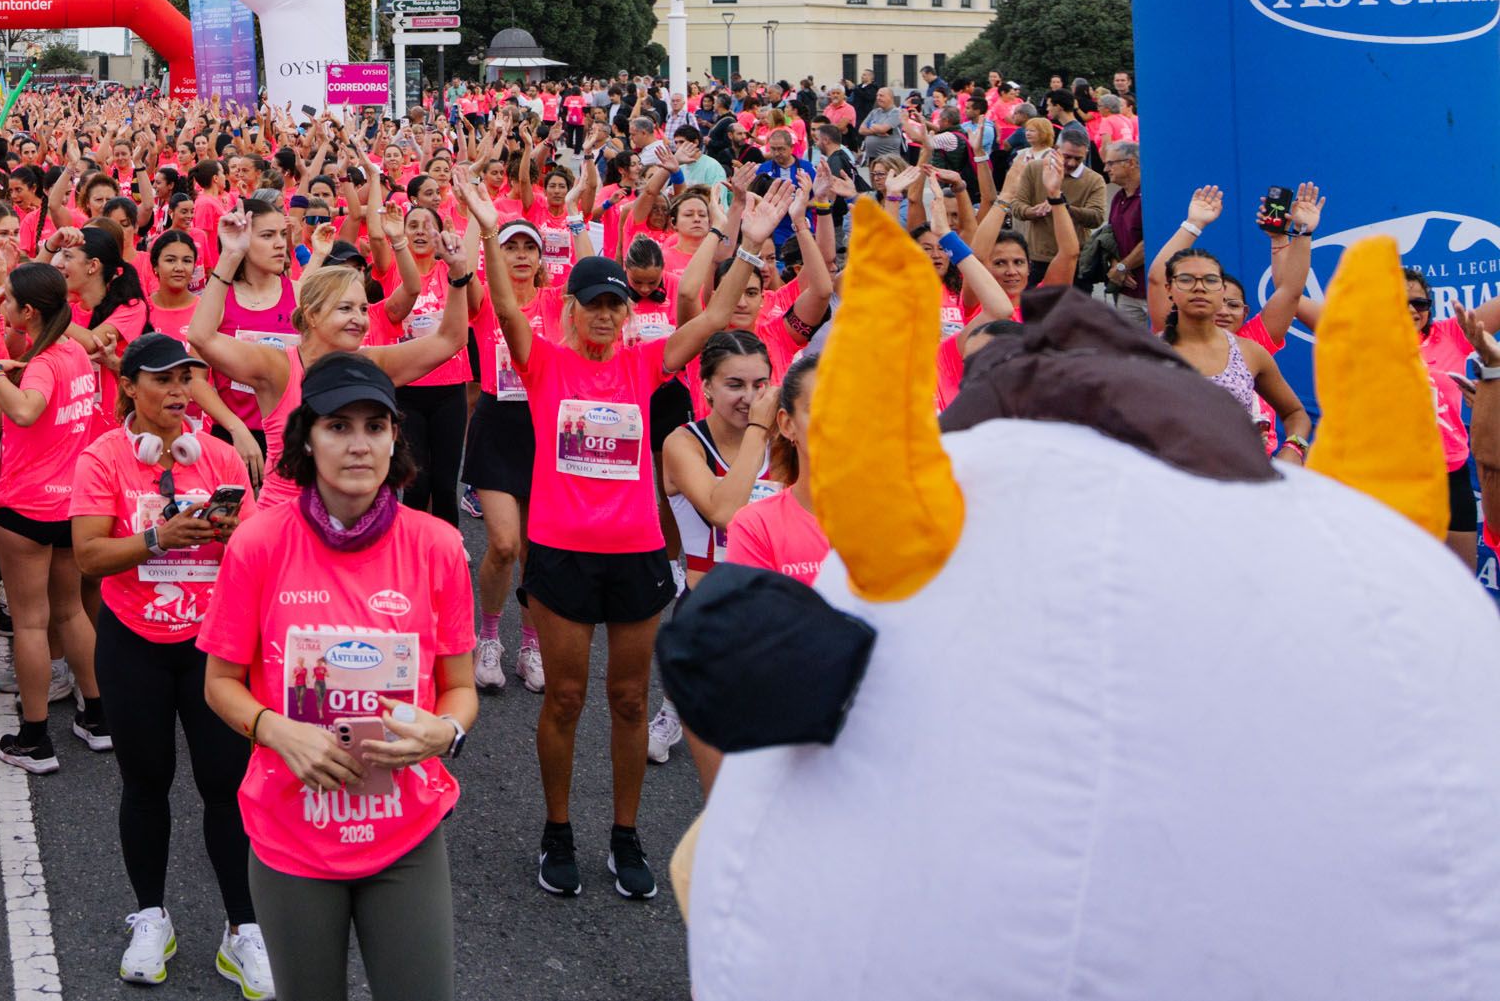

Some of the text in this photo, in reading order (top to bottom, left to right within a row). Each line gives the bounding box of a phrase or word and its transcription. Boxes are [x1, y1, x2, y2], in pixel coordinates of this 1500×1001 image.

[362, 68, 387, 76] OYSHO
[328, 82, 388, 93] CORREDORAS
[636, 312, 669, 325] RRERA
[72, 423, 85, 433] 26
[585, 436, 617, 450] 016
[148, 569, 178, 577] OYSHO
[279, 590, 330, 606] OYSHO
[372, 598, 409, 612] ASTURIANA
[296, 643, 321, 651] SUMA
[330, 651, 379, 663] ASTURIANA
[328, 690, 379, 712] 016
[303, 785, 403, 822] MUJER
[340, 825, 375, 844] 2026
